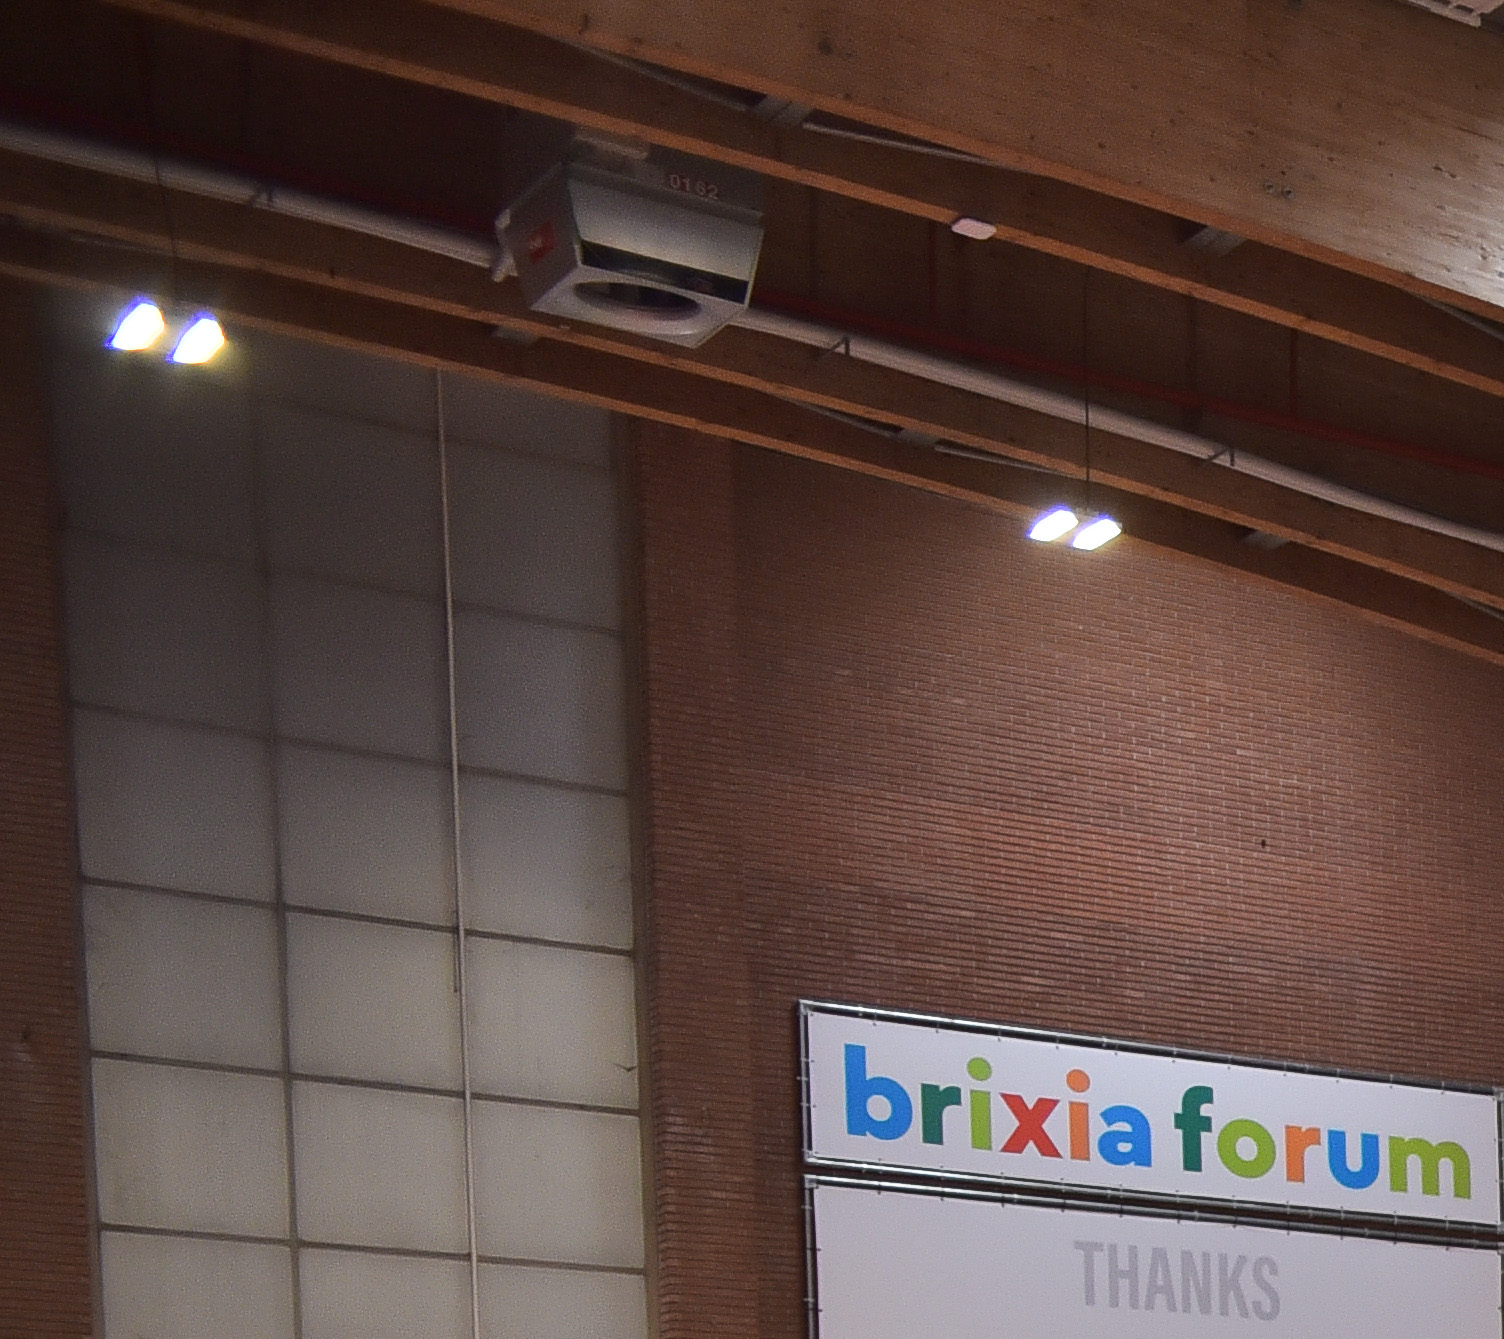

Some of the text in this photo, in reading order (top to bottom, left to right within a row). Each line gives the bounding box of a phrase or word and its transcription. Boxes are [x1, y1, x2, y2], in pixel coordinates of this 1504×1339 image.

[844, 1043, 1472, 1200] brixia forum
[1074, 1241, 1282, 1322] THANKS
